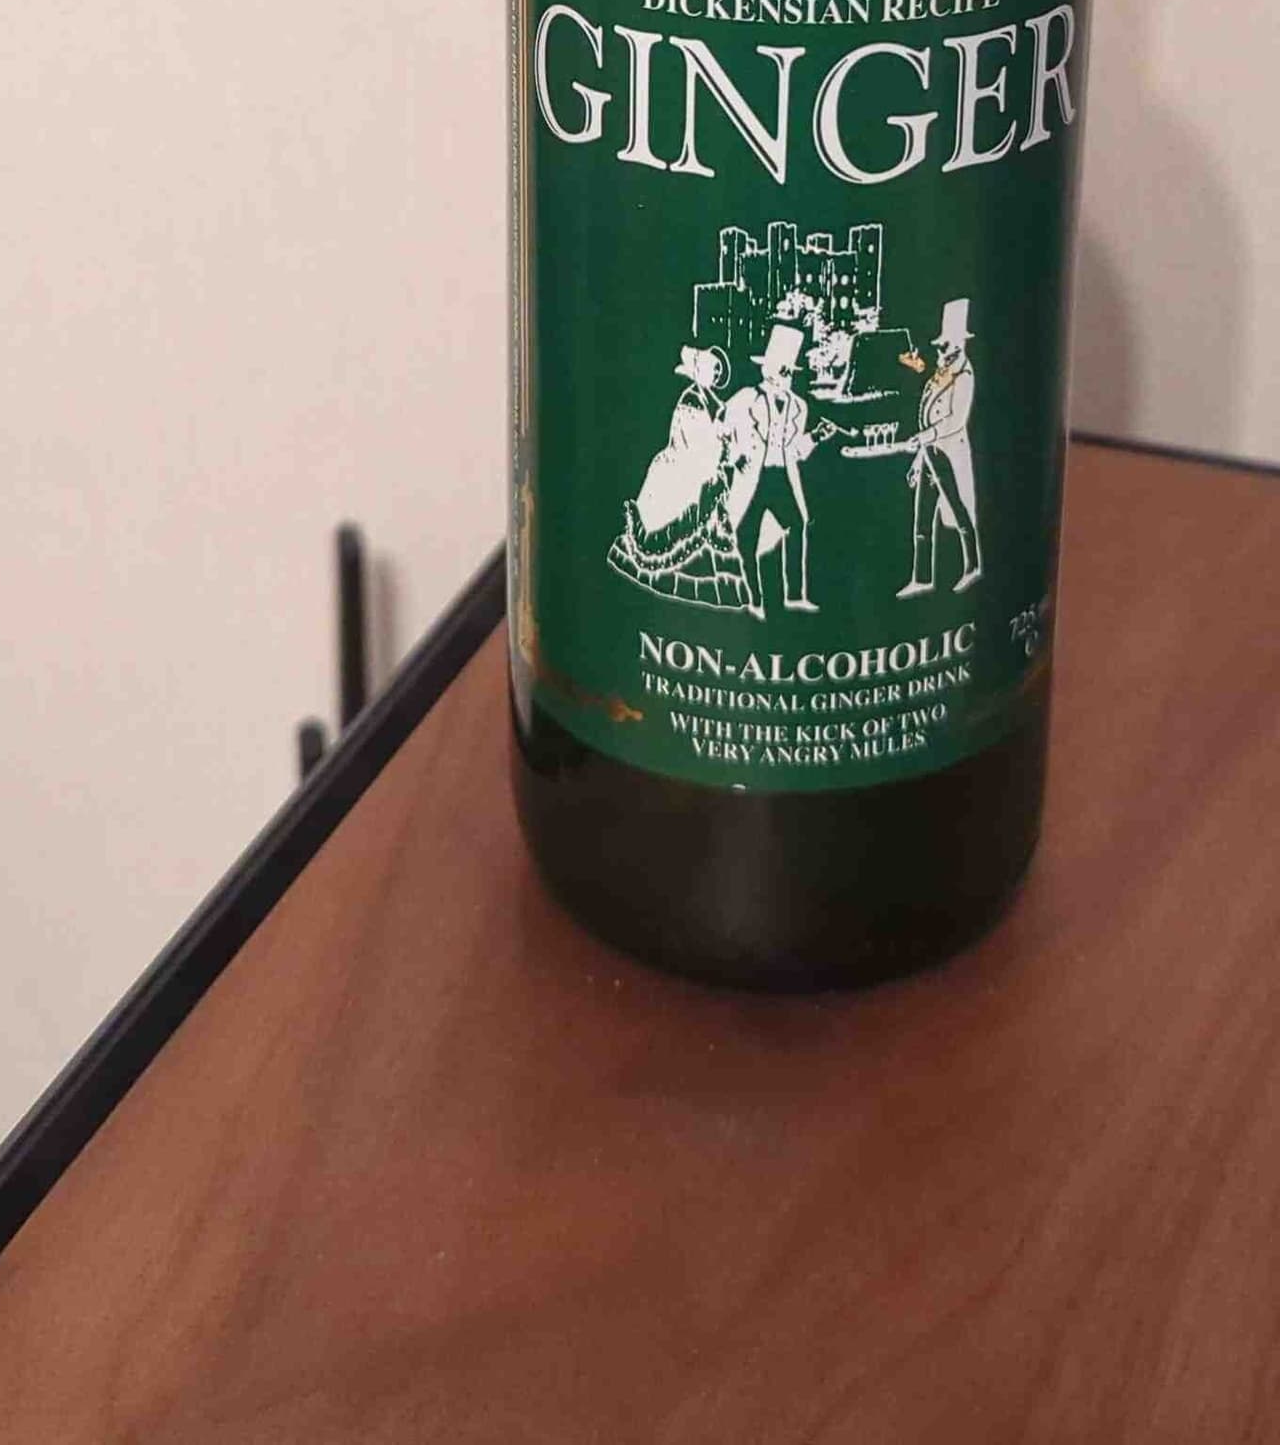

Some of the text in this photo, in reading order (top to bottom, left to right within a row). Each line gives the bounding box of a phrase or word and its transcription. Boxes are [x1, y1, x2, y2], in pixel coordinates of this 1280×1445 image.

[534, 3, 1077, 185] GINGER
[639, 622, 976, 682] NON-ALCOHOLIC
[641, 664, 971, 712] TRADITIONAL GINGER DRINK
[670, 703, 947, 744] WITH THE KICK OF TWO
[692, 731, 927, 765] VERY ANGRY MULES
